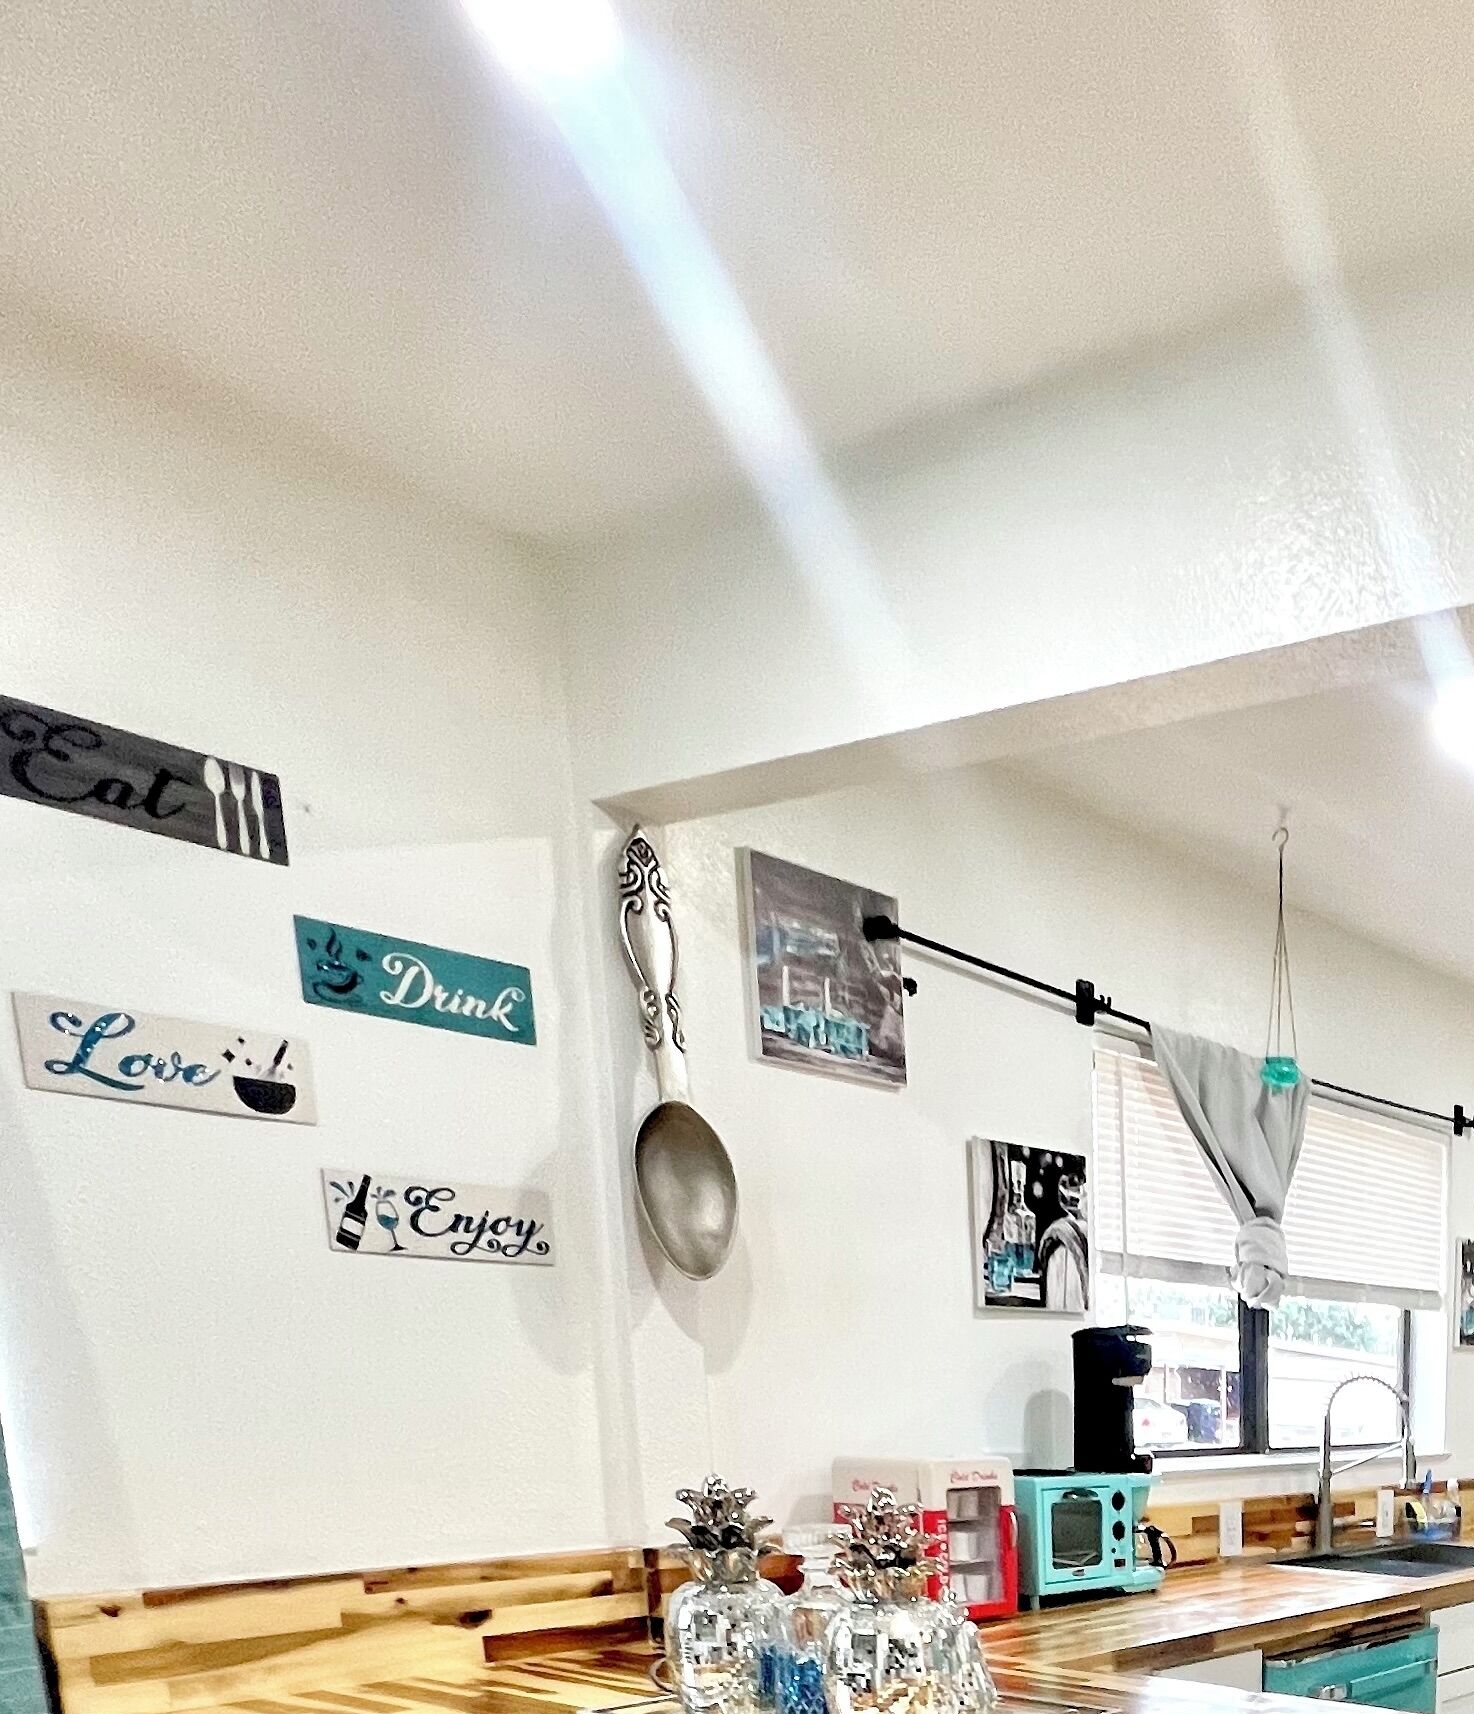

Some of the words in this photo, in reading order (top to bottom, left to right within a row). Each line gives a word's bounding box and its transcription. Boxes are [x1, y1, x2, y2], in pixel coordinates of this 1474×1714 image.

[0, 708, 193, 819] Eat
[379, 952, 527, 1032] Drink
[44, 1011, 221, 1091] Love
[403, 1186, 550, 1257] Enjoy
